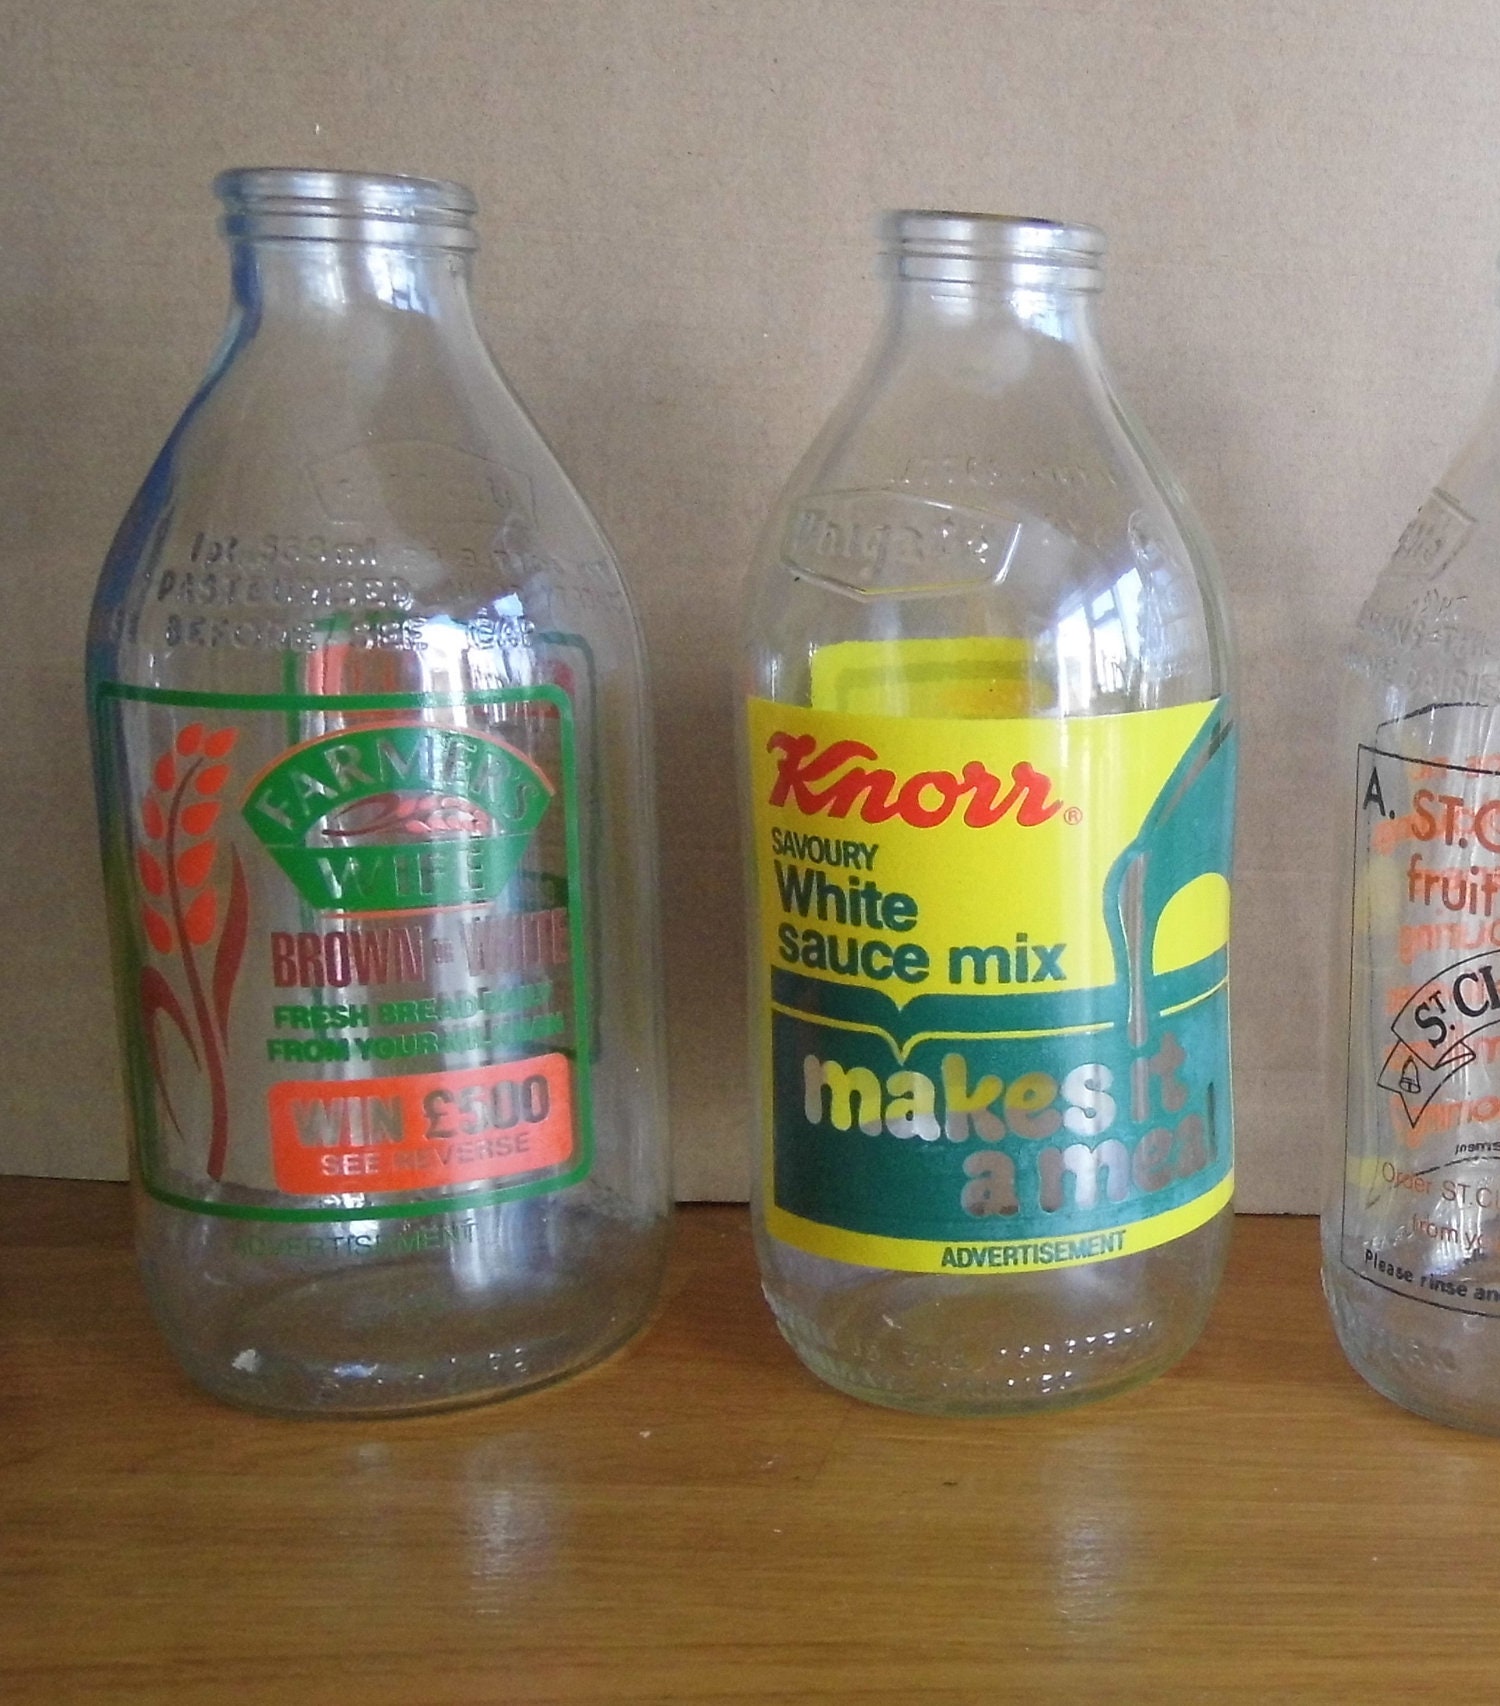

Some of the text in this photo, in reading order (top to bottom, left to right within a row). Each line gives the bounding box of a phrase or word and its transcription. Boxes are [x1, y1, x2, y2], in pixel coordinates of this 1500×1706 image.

[766, 730, 1066, 830] Knorr
[1361, 766, 1396, 819] A.
[315, 852, 486, 898] WIFE
[771, 826, 879, 872] SAVOURY
[773, 860, 919, 932] White
[1407, 854, 1500, 917] fruit
[270, 925, 427, 988] BROWN
[778, 923, 1068, 985] sauce mix
[272, 1003, 369, 1030] FRESH
[266, 1036, 351, 1064] FROM
[356, 1030, 441, 1061] YOUR
[290, 1074, 551, 1149] WIN £500
[801, 1032, 1189, 1143] makes it
[321, 1131, 532, 1178] SEE REVERSE
[960, 1082, 1218, 1218] a meal
[1381, 1161, 1433, 1195] Order
[940, 1230, 1127, 1269] ADVERTISEMENT
[1411, 1212, 1460, 1246] from
[1364, 1248, 1415, 1284] Please
[1418, 1271, 1470, 1299] rinse
